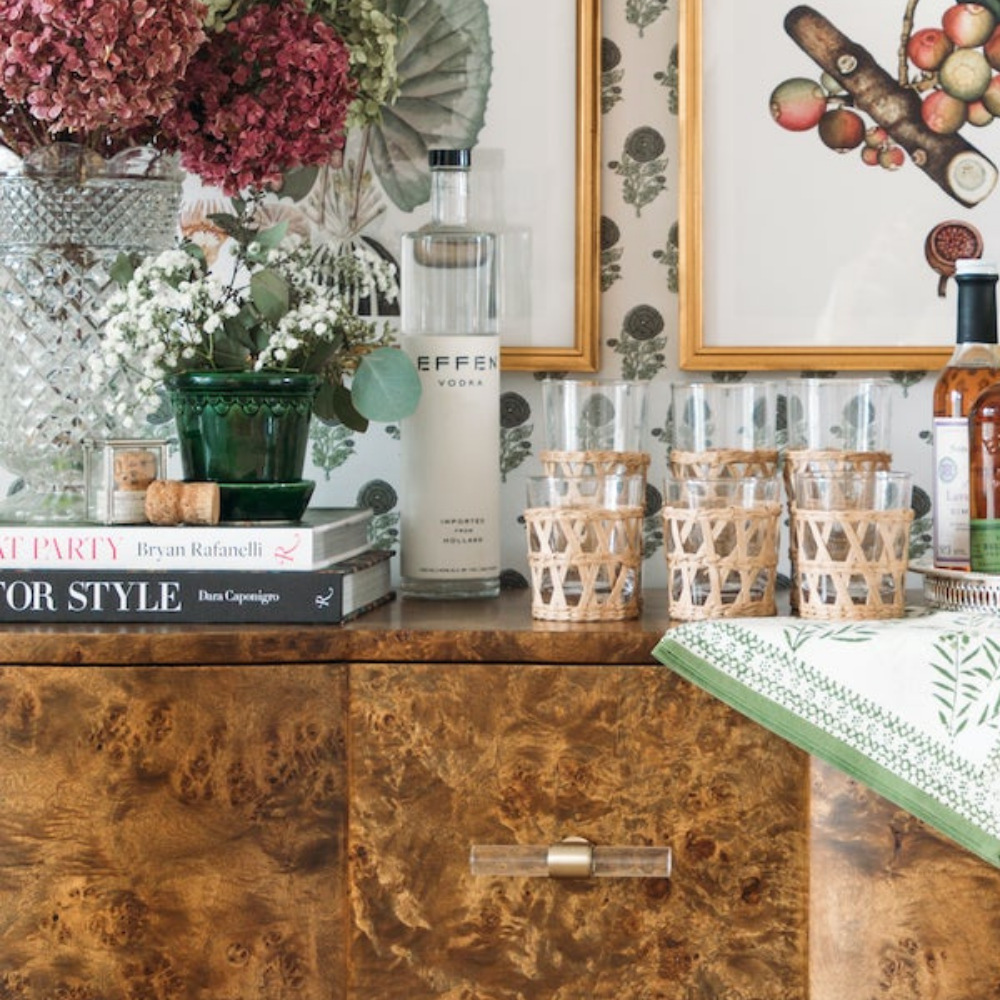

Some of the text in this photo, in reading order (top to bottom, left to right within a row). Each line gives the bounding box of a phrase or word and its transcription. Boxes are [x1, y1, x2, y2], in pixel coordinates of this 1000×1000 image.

[417, 356, 497, 371] EFFEN
[438, 379, 483, 388] VODKA
[33, 536, 124, 561] PARTY
[137, 540, 263, 562] Bryan Rafanelli
[67, 580, 183, 612] STYLE
[198, 589, 280, 605] Dara Caponigro
